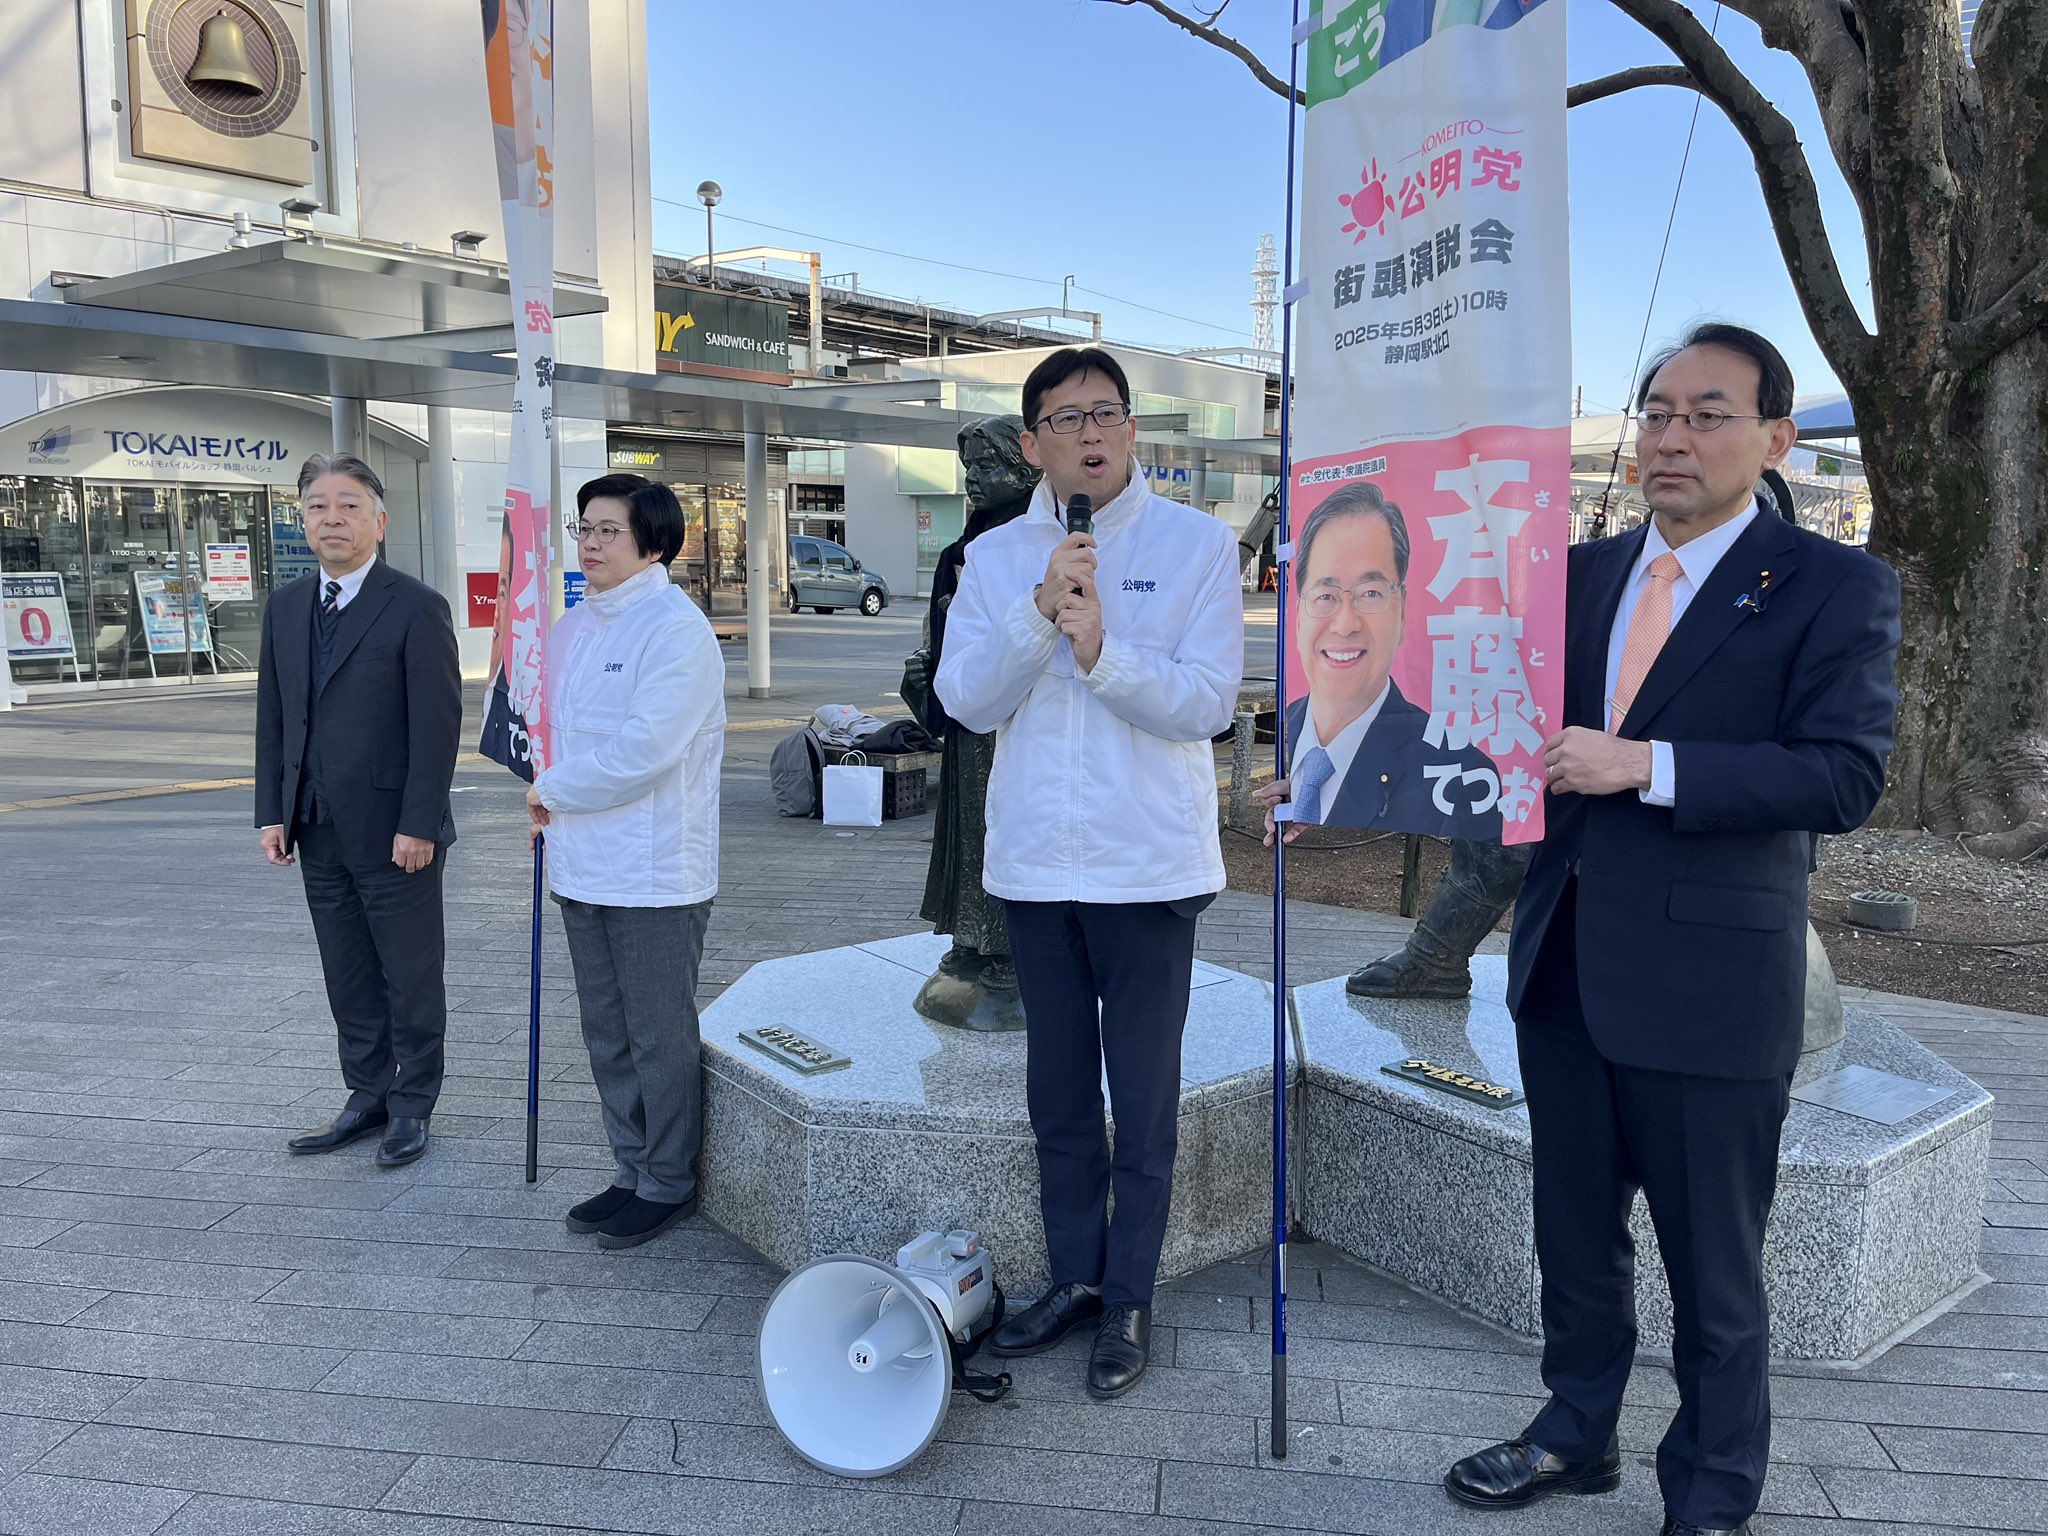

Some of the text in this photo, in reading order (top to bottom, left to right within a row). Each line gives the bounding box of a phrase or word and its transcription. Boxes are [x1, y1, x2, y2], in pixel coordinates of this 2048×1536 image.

[1421, 119, 1484, 156] KOMEITO
[1400, 145, 1523, 219] 公明党
[1333, 218, 1515, 309] 街頭演説会
[705, 332, 786, 355] SANDWICH & CAFÉ
[1384, 330, 1450, 365] 静岡駅北口
[104, 430, 288, 461] TOKAIモバイル
[126, 459, 153, 467] TOKAI
[613, 450, 660, 465] SUBWAY
[1121, 579, 1156, 592] 公明党
[20, 607, 52, 646] 0
[1423, 762, 1543, 823] てつお
